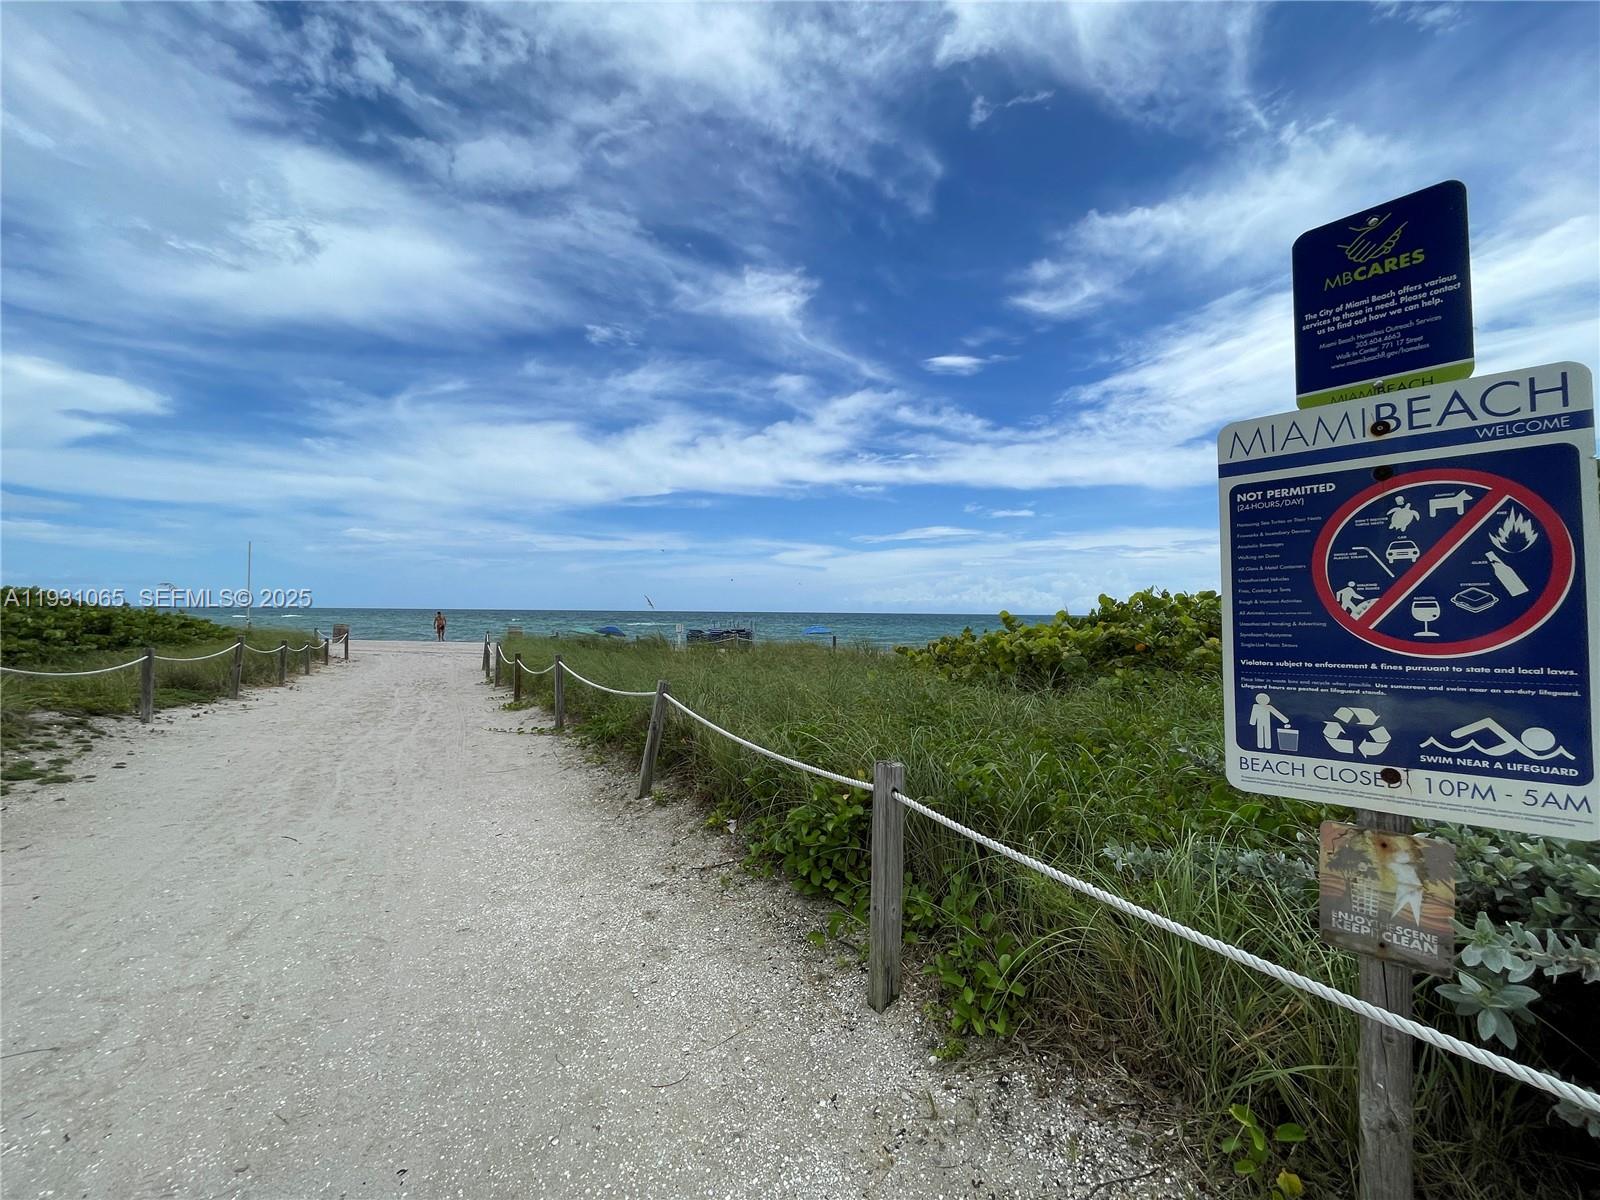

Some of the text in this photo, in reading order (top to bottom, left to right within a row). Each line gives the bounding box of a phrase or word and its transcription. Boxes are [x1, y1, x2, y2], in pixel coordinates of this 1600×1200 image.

[1324, 249, 1425, 291] MBCARES
[1302, 319, 1331, 331] services
[1342, 308, 1363, 319] those
[1375, 299, 1398, 311] need.
[1400, 291, 1427, 304] Please
[1429, 282, 1461, 296] contact
[1319, 309, 1333, 318] City
[1335, 304, 1344, 313] of
[1345, 297, 1370, 310] Miami
[1371, 290, 1396, 302] Beach
[1397, 284, 1422, 295] offers
[1424, 273, 1457, 287] various
[1327, 324, 1335, 332] to
[1337, 319, 1352, 330] find
[1354, 317, 1367, 325] out
[1369, 310, 1387, 322] how
[1389, 307, 1403, 315] we
[1404, 303, 1420, 312] can
[1422, 297, 1444, 308] help.
[1319, 341, 1337, 350] Miami
[1338, 335, 1356, 345] Beach
[1385, 320, 1414, 334] Outreach
[1416, 315, 1442, 326] Services
[1475, 415, 1570, 439] WELCOME
[1237, 483, 1336, 502] NOT PERMITTED
[1237, 498, 1305, 512] (24-HOURS/DAY)
[1240, 659, 1274, 667] Violators
[1275, 660, 1302, 669] subject
[1315, 662, 1368, 670] enforcement
[1381, 663, 1403, 671] fines
[1405, 665, 1450, 673] pursuant
[1518, 667, 1544, 675] local
[1547, 668, 1578, 676] laws.
[1504, 688, 1536, 696] on-duty
[1420, 755, 1453, 765] SWIM
[1456, 758, 1490, 769] NEAR
[1507, 763, 1579, 777] LIFEGUARD
[1239, 756, 1305, 777] BEACH
[1425, 777, 1496, 802] 10PM
[1522, 789, 1592, 814] 5AM
[1332, 918, 1371, 935] KEEP
[1382, 932, 1438, 955] CLEAN
[1395, 926, 1439, 944] SCENE
